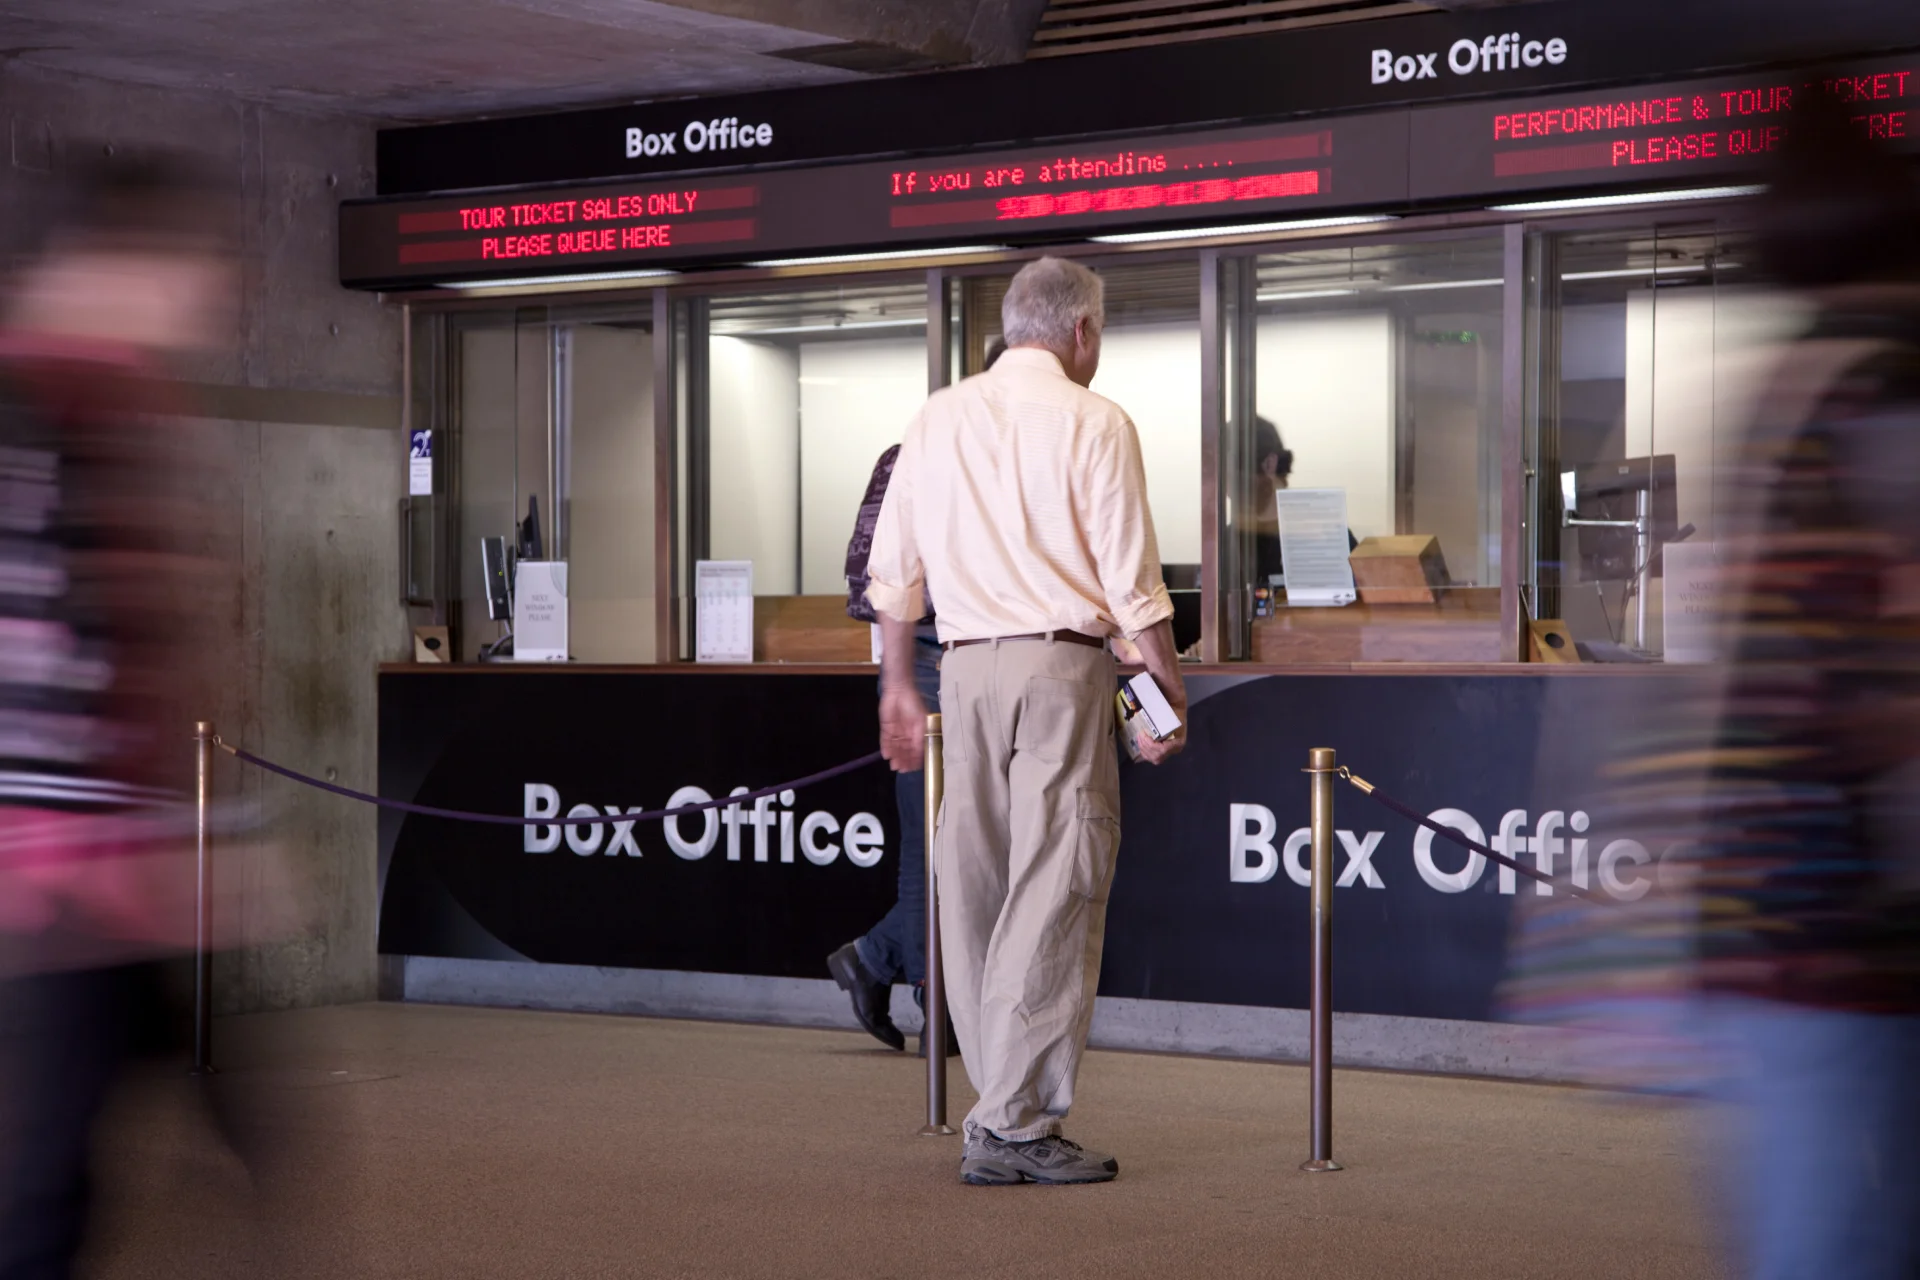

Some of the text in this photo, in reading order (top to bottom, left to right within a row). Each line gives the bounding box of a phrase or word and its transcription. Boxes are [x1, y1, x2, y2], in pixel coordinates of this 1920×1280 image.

[1371, 31, 1568, 84] Box Office
[1494, 71, 1910, 140] PERFORMANCE & TOUR CKET
[627, 117, 773, 158] Box Office
[1612, 132, 1718, 166] PLEASE
[1728, 126, 1789, 155] QUE
[892, 171, 917, 196] If
[929, 172, 971, 192] you
[984, 167, 1025, 188] are
[1039, 152, 1167, 183] attending
[460, 191, 698, 230] TOUR TICKET SALES ONLY
[482, 224, 671, 260] PLEASE QUEUE HERE
[524, 782, 886, 868] Box Office
[1412, 807, 1698, 901] Offic
